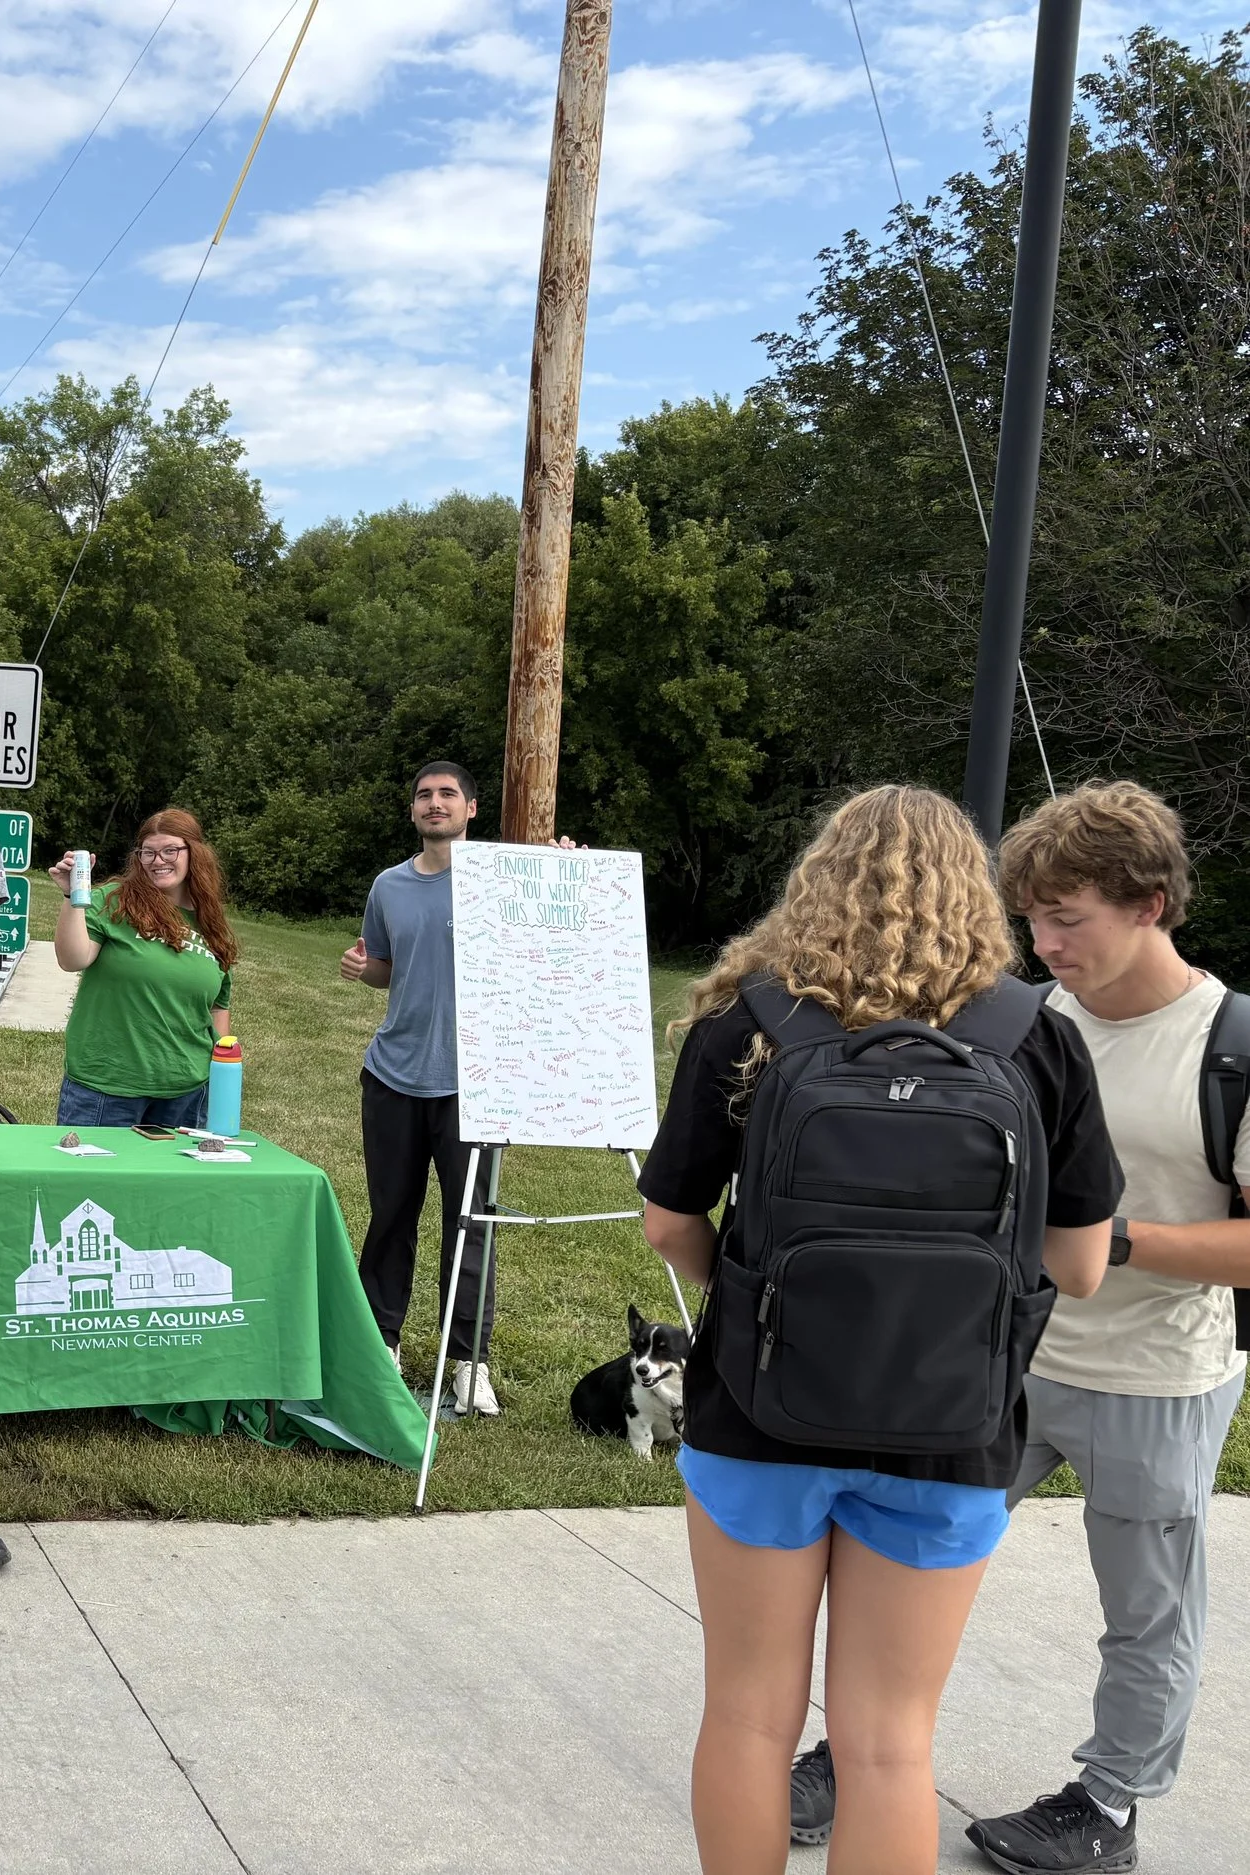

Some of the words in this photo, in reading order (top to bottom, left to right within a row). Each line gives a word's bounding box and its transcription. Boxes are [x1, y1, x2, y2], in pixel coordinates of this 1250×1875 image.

[9, 819, 26, 837] OF
[498, 855, 544, 880] FAVORITE
[558, 858, 587, 882] PLACE
[516, 878, 541, 899] YOU
[547, 882, 578, 902] WENT
[502, 899, 528, 923] THIS
